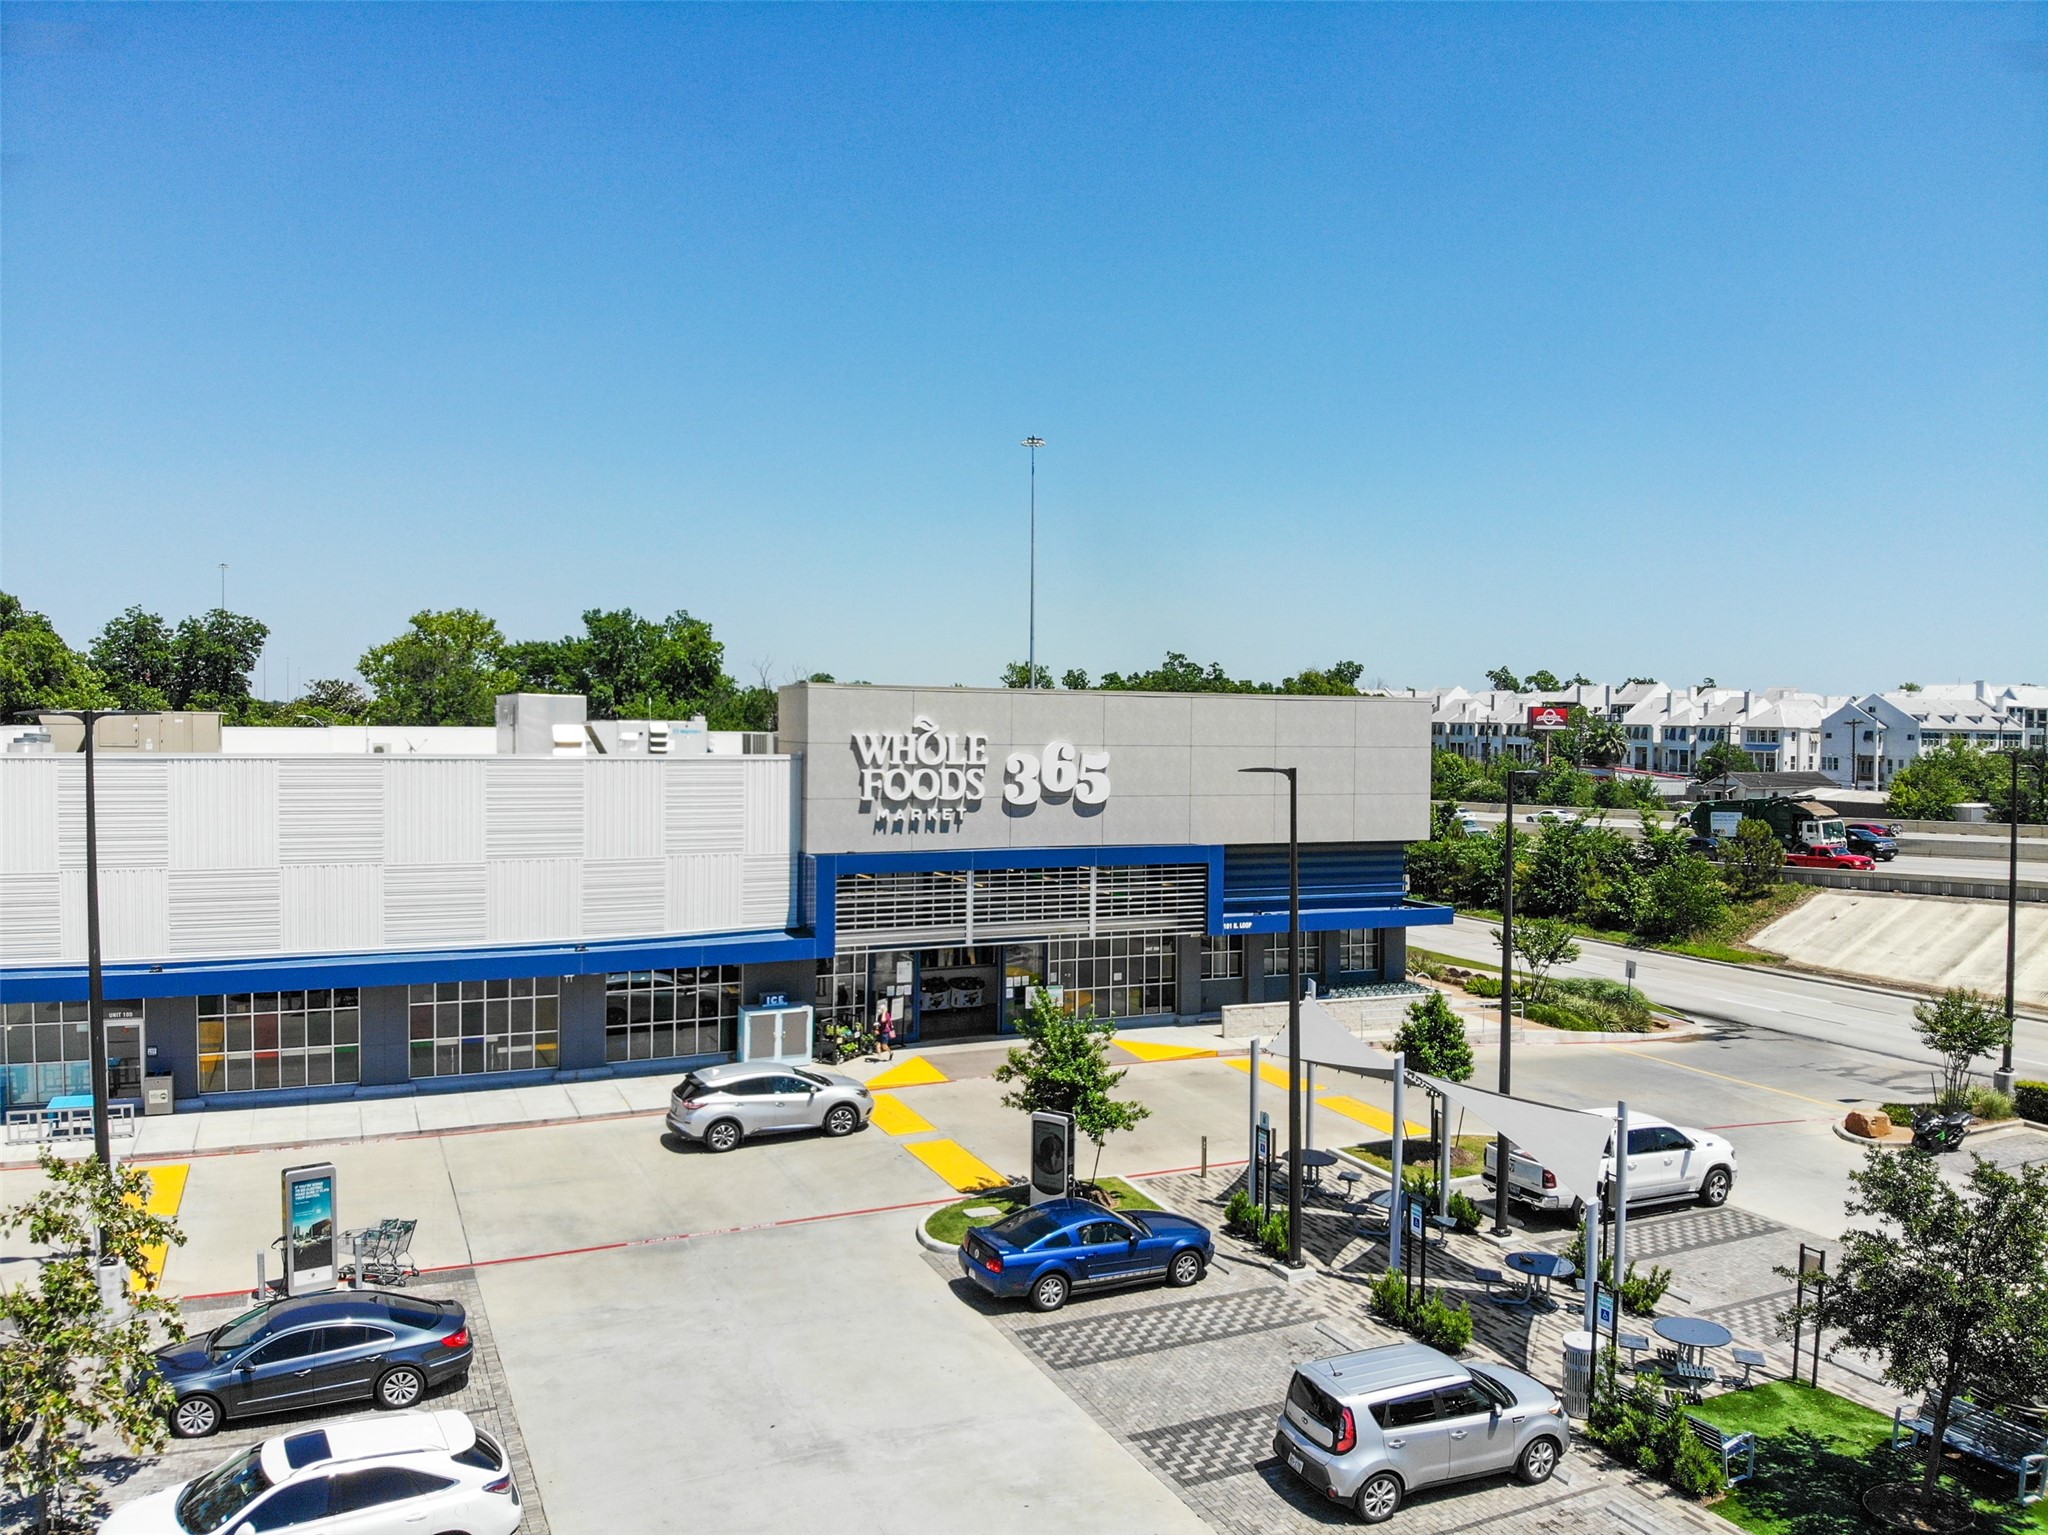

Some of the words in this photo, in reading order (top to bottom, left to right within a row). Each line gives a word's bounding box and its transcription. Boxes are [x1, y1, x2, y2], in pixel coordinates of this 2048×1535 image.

[851, 732, 989, 766] WHOLE
[860, 768, 986, 801] FOODS
[1004, 740, 1111, 806] 365
[876, 807, 967, 822] MARKET
[766, 995, 788, 1006] ICE
